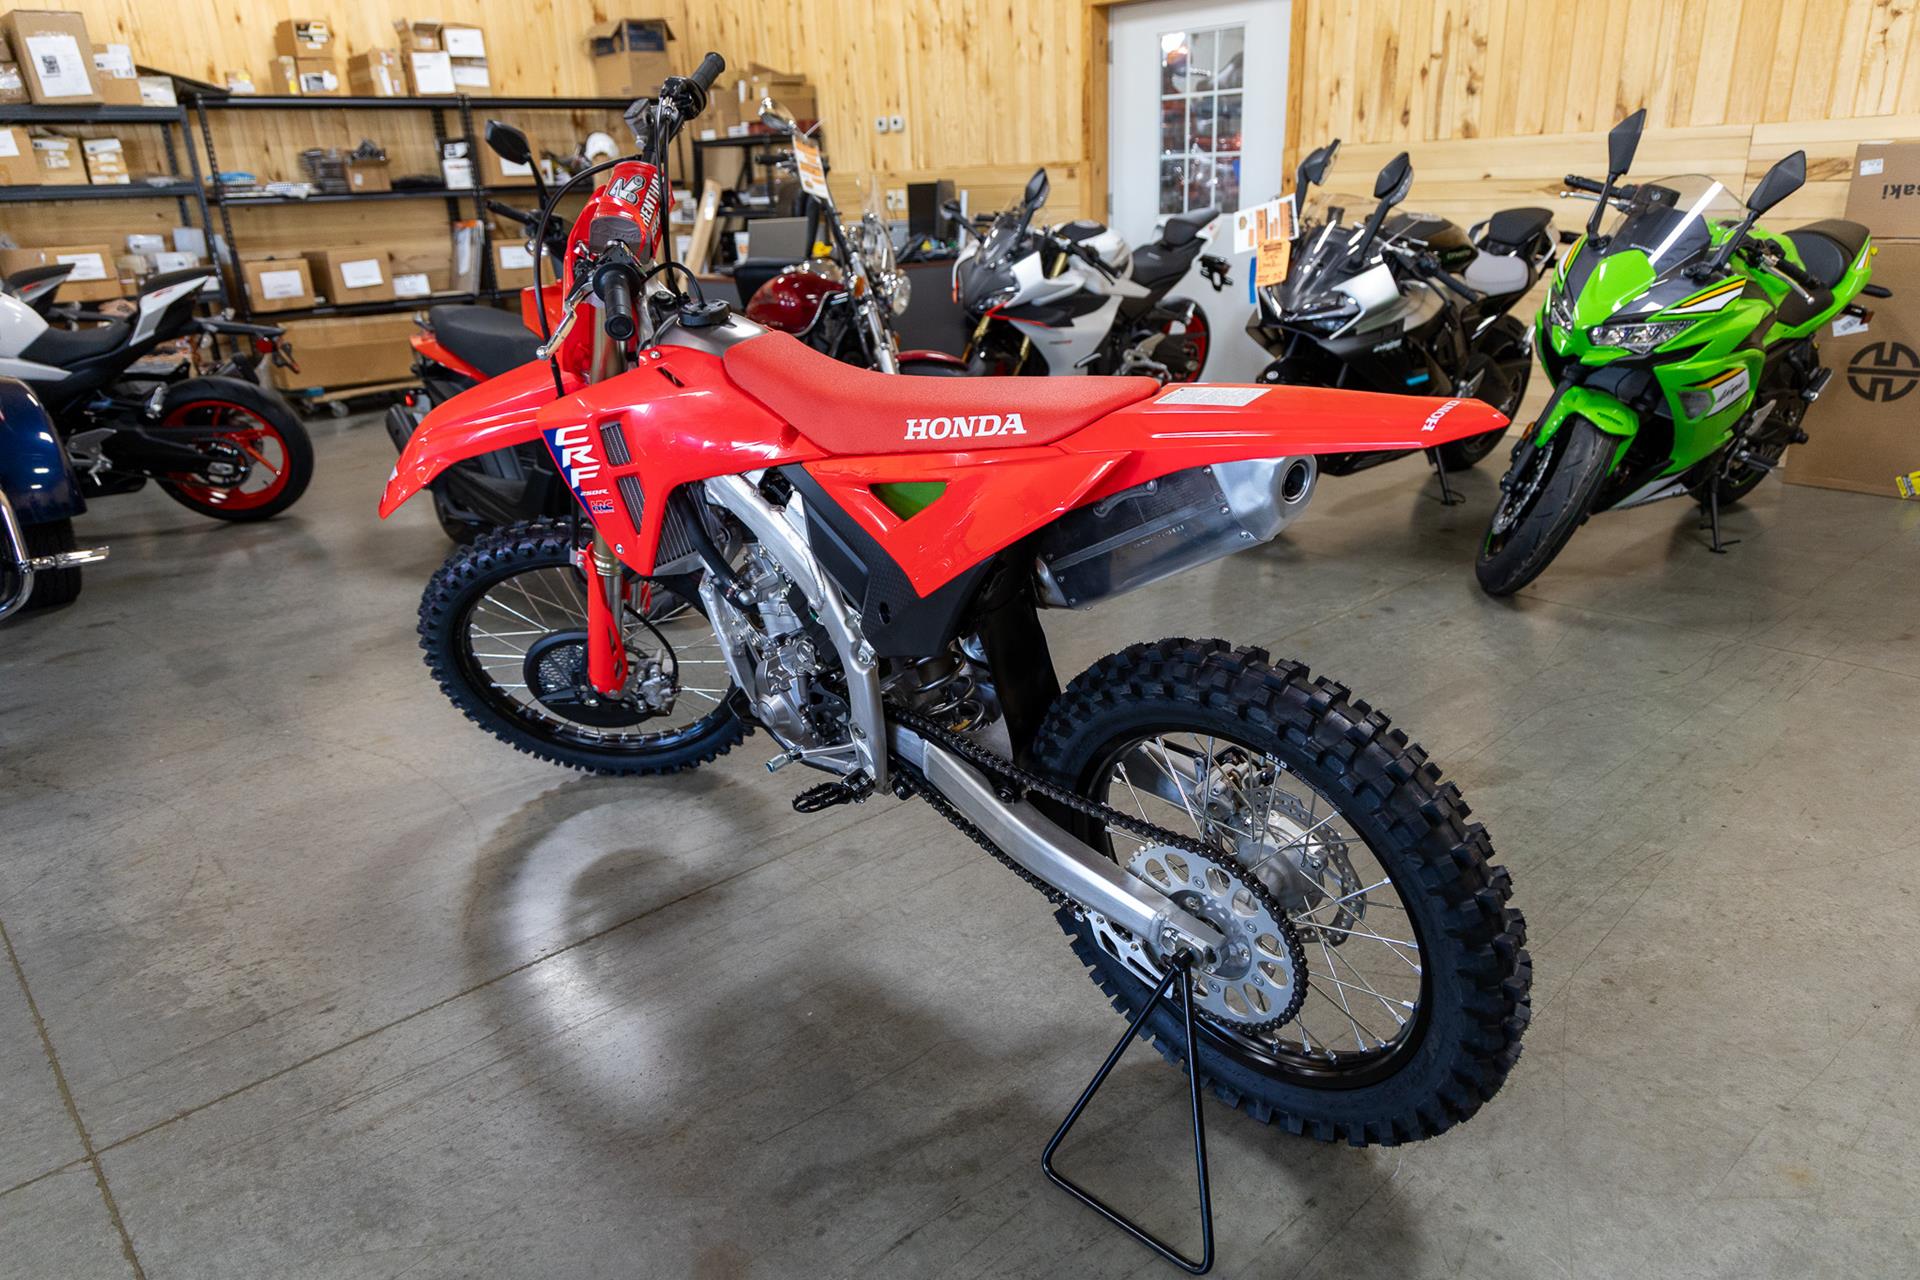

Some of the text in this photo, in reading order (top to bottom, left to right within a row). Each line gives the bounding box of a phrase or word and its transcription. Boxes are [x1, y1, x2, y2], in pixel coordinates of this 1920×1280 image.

[903, 413, 1027, 440] HONDA
[1421, 400, 1460, 432] HOND
[554, 424, 600, 489] CRF
